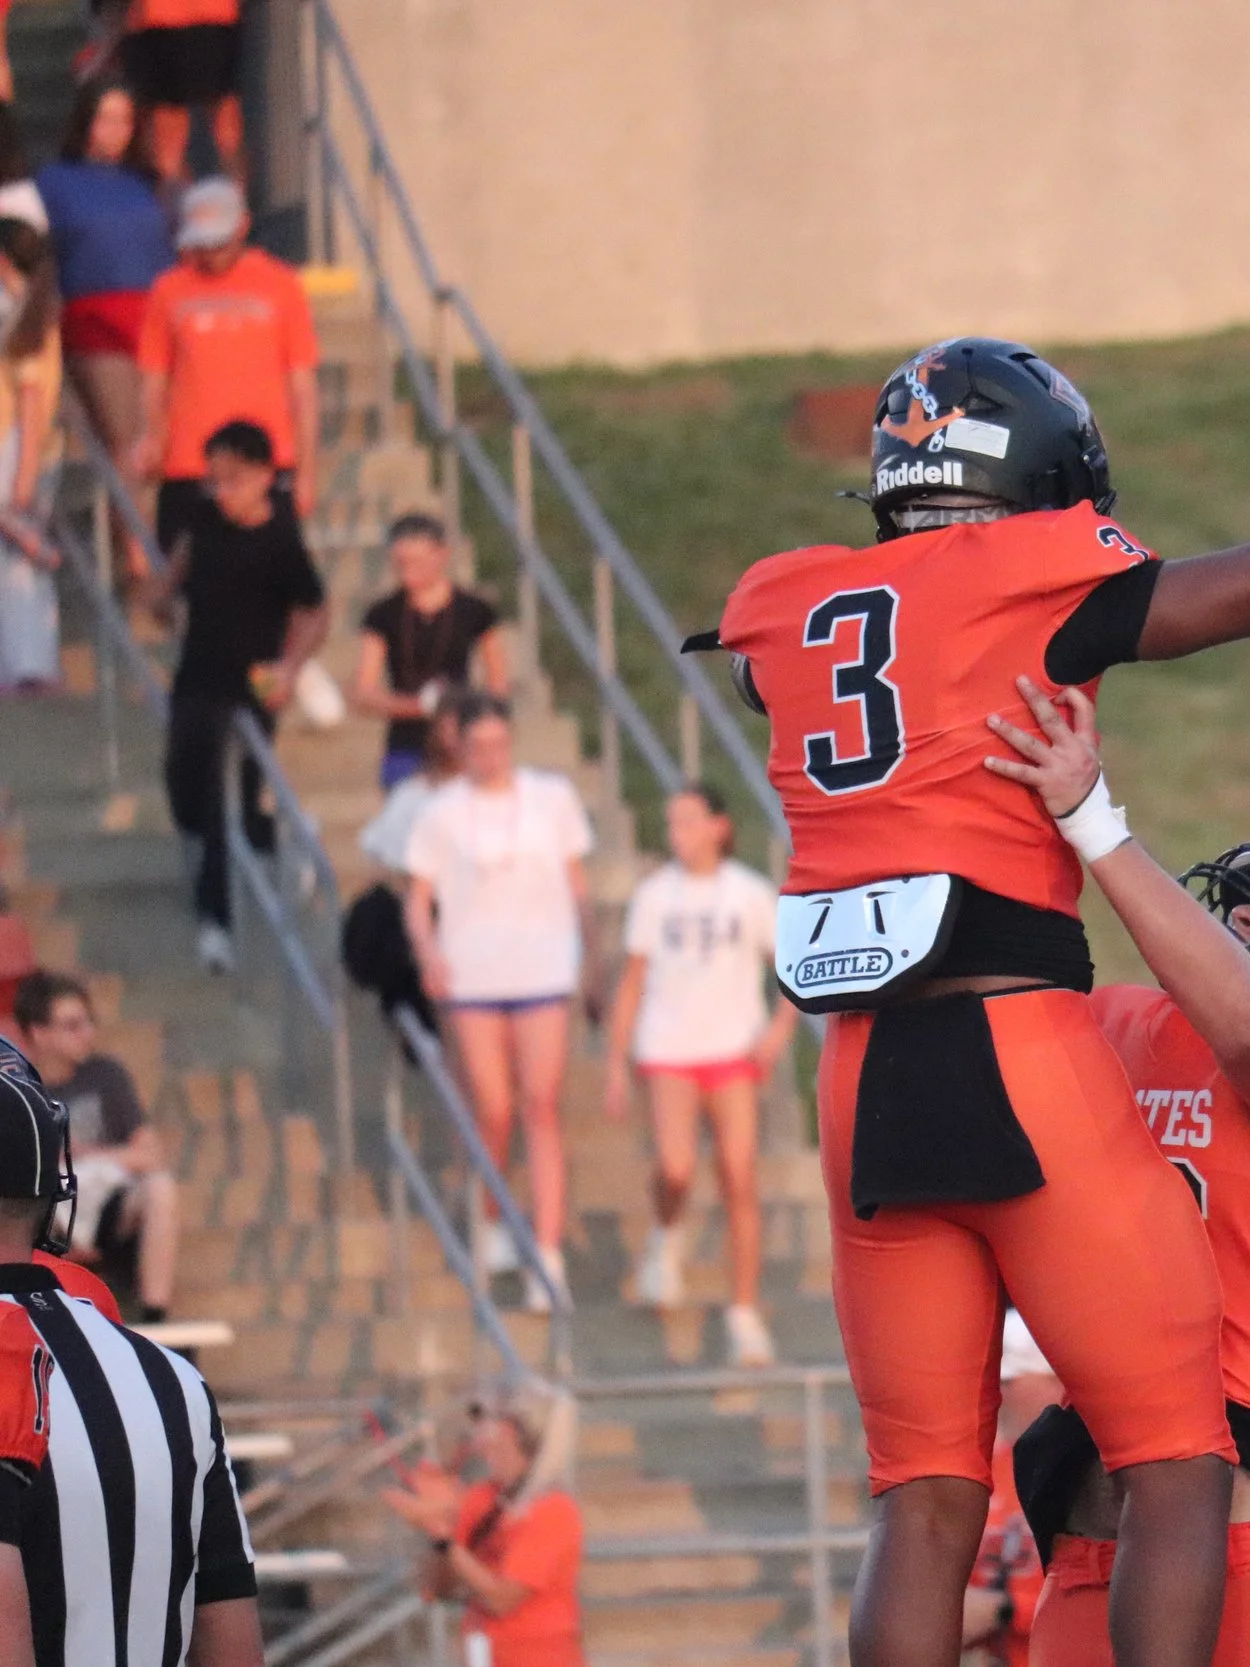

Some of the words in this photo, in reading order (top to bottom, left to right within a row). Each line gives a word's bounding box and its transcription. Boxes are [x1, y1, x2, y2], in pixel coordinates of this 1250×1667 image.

[876, 461, 963, 496] Riddell
[802, 584, 907, 797] 3
[801, 954, 883, 982] BATTLE
[1135, 1088, 1213, 1148] TES
